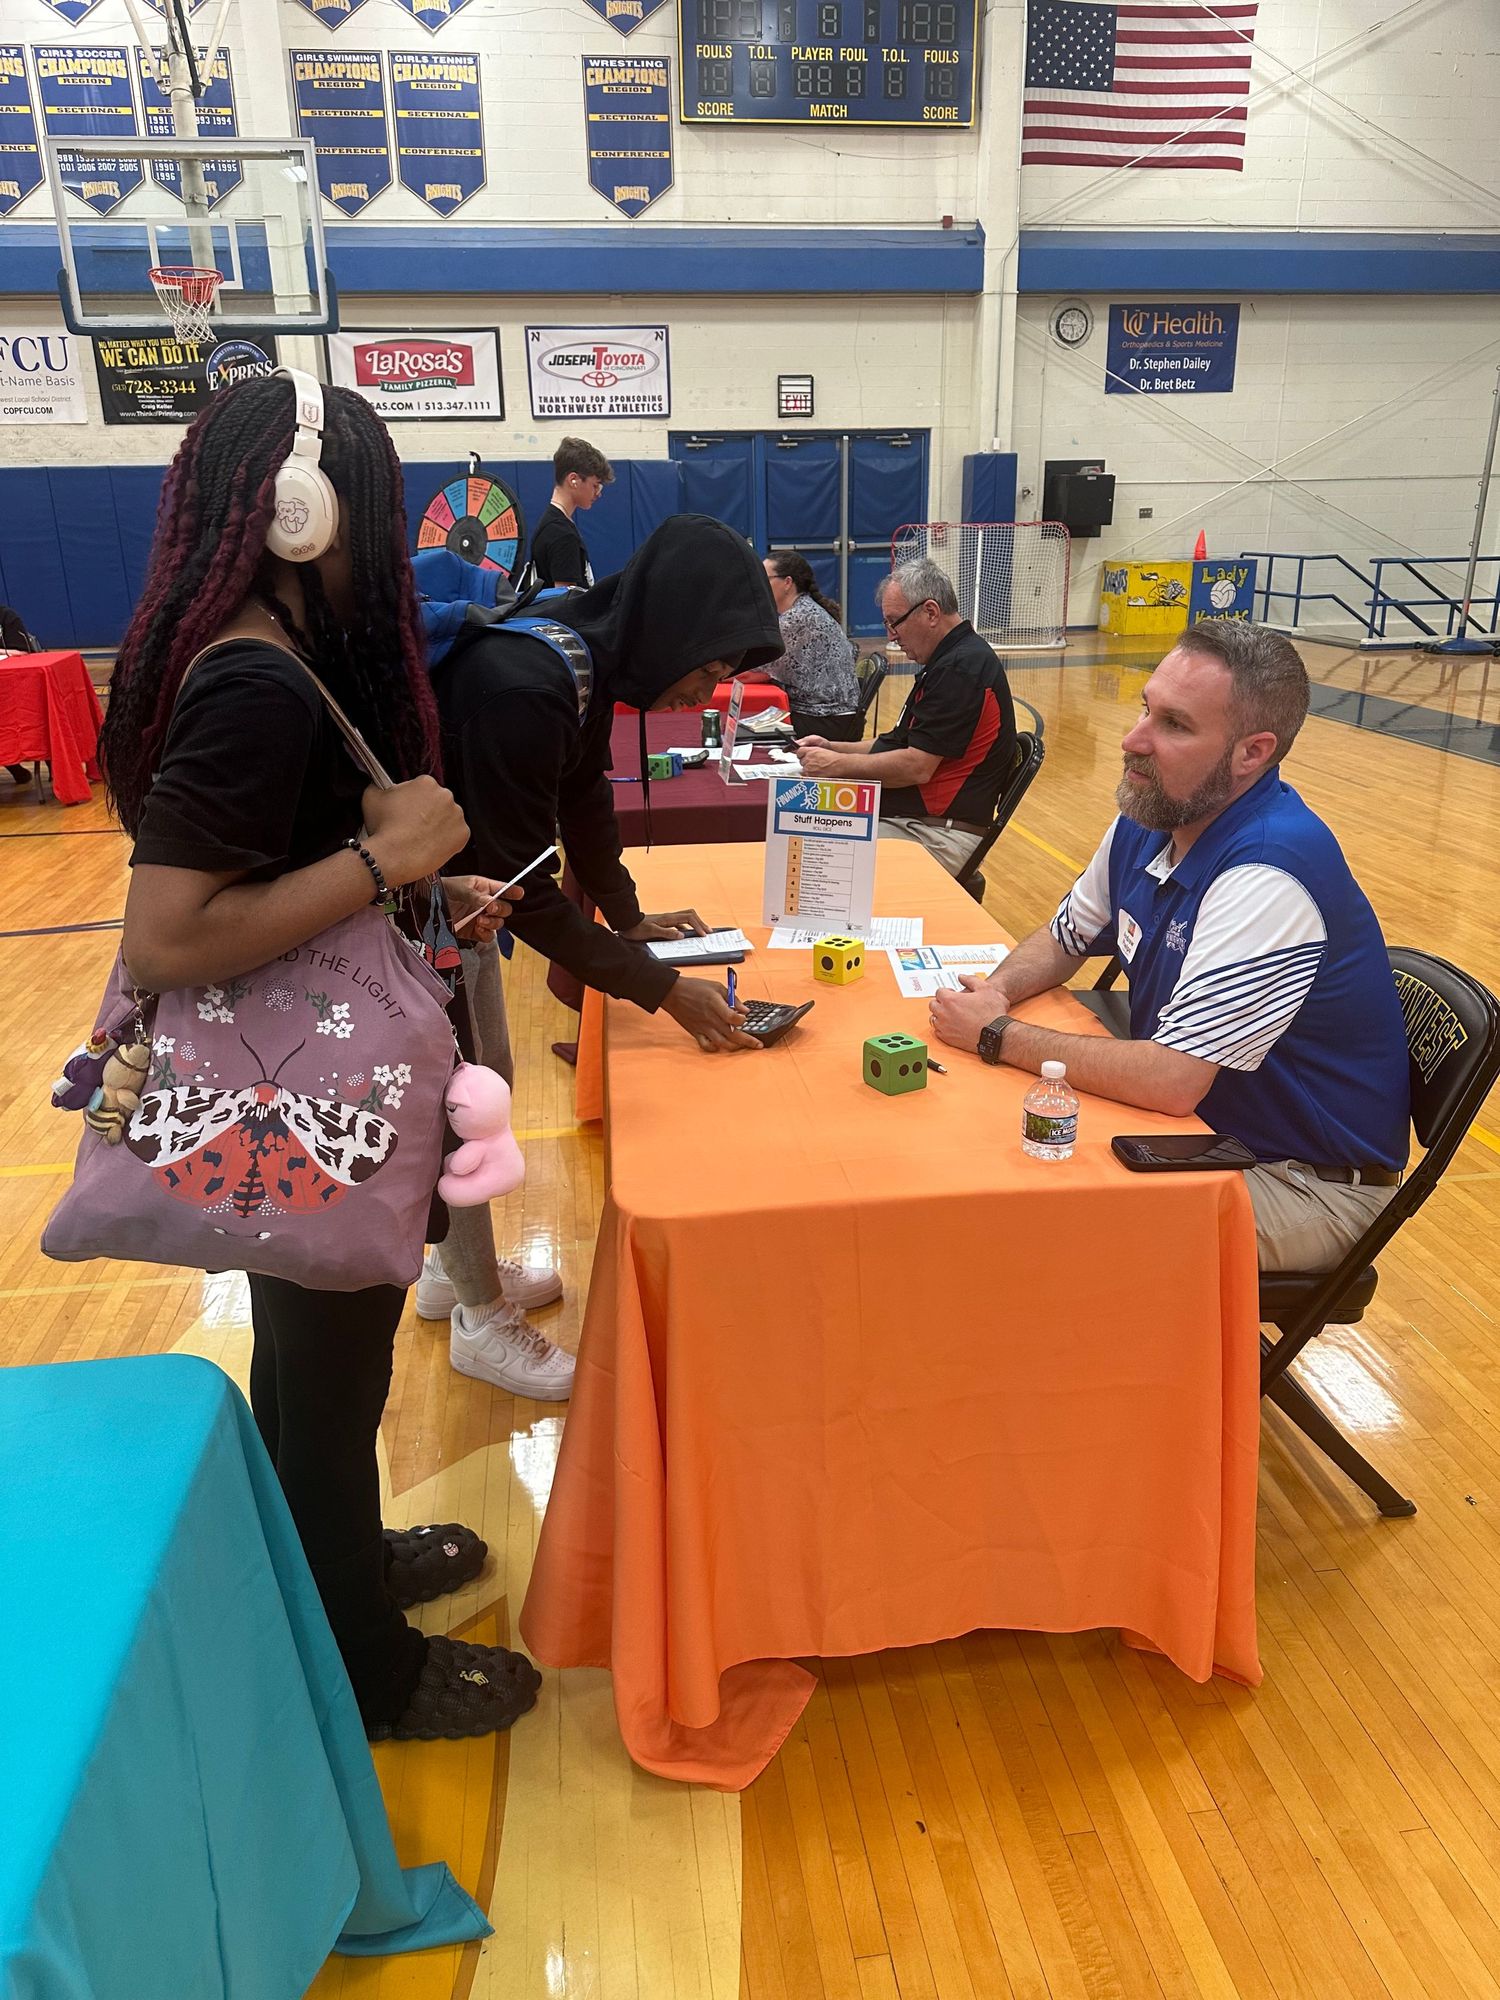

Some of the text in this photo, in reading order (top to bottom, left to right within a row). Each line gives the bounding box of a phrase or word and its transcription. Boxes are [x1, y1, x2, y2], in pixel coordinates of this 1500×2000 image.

[40, 49, 121, 58] GIRLS SOCCER
[327, 54, 377, 62] SWIMMING
[696, 45, 732, 58] FOULS
[748, 46, 777, 59] T.O.L.
[791, 47, 868, 61] PLAYER FOUL
[881, 49, 910, 62] T.O.L.
[924, 50, 959, 63] FOULS
[395, 55, 474, 64] GIRLS TENNIS
[589, 59, 664, 68] WRESTLING
[38, 58, 127, 78] CHAMPIONS
[295, 62, 380, 82] CHAMPIONS
[393, 63, 477, 84] CHAMPIONS
[586, 67, 667, 87] CHAMPIONS
[697, 102, 734, 116] SCORE
[810, 104, 848, 117] MATCH
[923, 106, 959, 119] SCORE
[149, 116, 168, 124] 1991
[213, 116, 232, 125] 1994
[151, 125, 169, 133] 1995
[82, 181, 120, 199] KNIGHTS
[331, 183, 369, 200] KNIGHTS
[425, 184, 463, 202] KNIGHTS
[614, 186, 651, 203] KNIGHTS
[1153, 311, 1222, 335] Health
[107, 340, 131, 349] MATTER
[131, 340, 147, 348] WHAT
[147, 339, 160, 347] YOU
[160, 338, 175, 346] NEED
[100, 348, 126, 368] WE
[127, 347, 159, 366] CAN
[162, 345, 184, 364] DO
[185, 344, 204, 363] IT.
[548, 346, 645, 370] JOSEPH TOYOTA
[1129, 357, 1211, 372] Dr. Stephen Dailey
[45, 375, 76, 387] Basis
[125, 380, 197, 394] 728-3344
[384, 379, 452, 391] FAMILY PIZZERIA
[1140, 378, 1195, 390] Dr. Bret Betz
[591, 395, 606, 403] FOR
[610, 395, 662, 403] SPONSORING
[785, 395, 809, 411] EXIT
[3, 406, 54, 415] COPFCU.COM
[424, 401, 491, 411] 513.347.1111
[540, 403, 663, 413] NORTHWEST ATHLETICS
[1202, 565, 1249, 588] Lady
[776, 781, 808, 808] FINANCES
[793, 814, 853, 828] Stuff Happens
[308, 950, 350, 975] THE
[351, 967, 407, 1019] LIGHT
